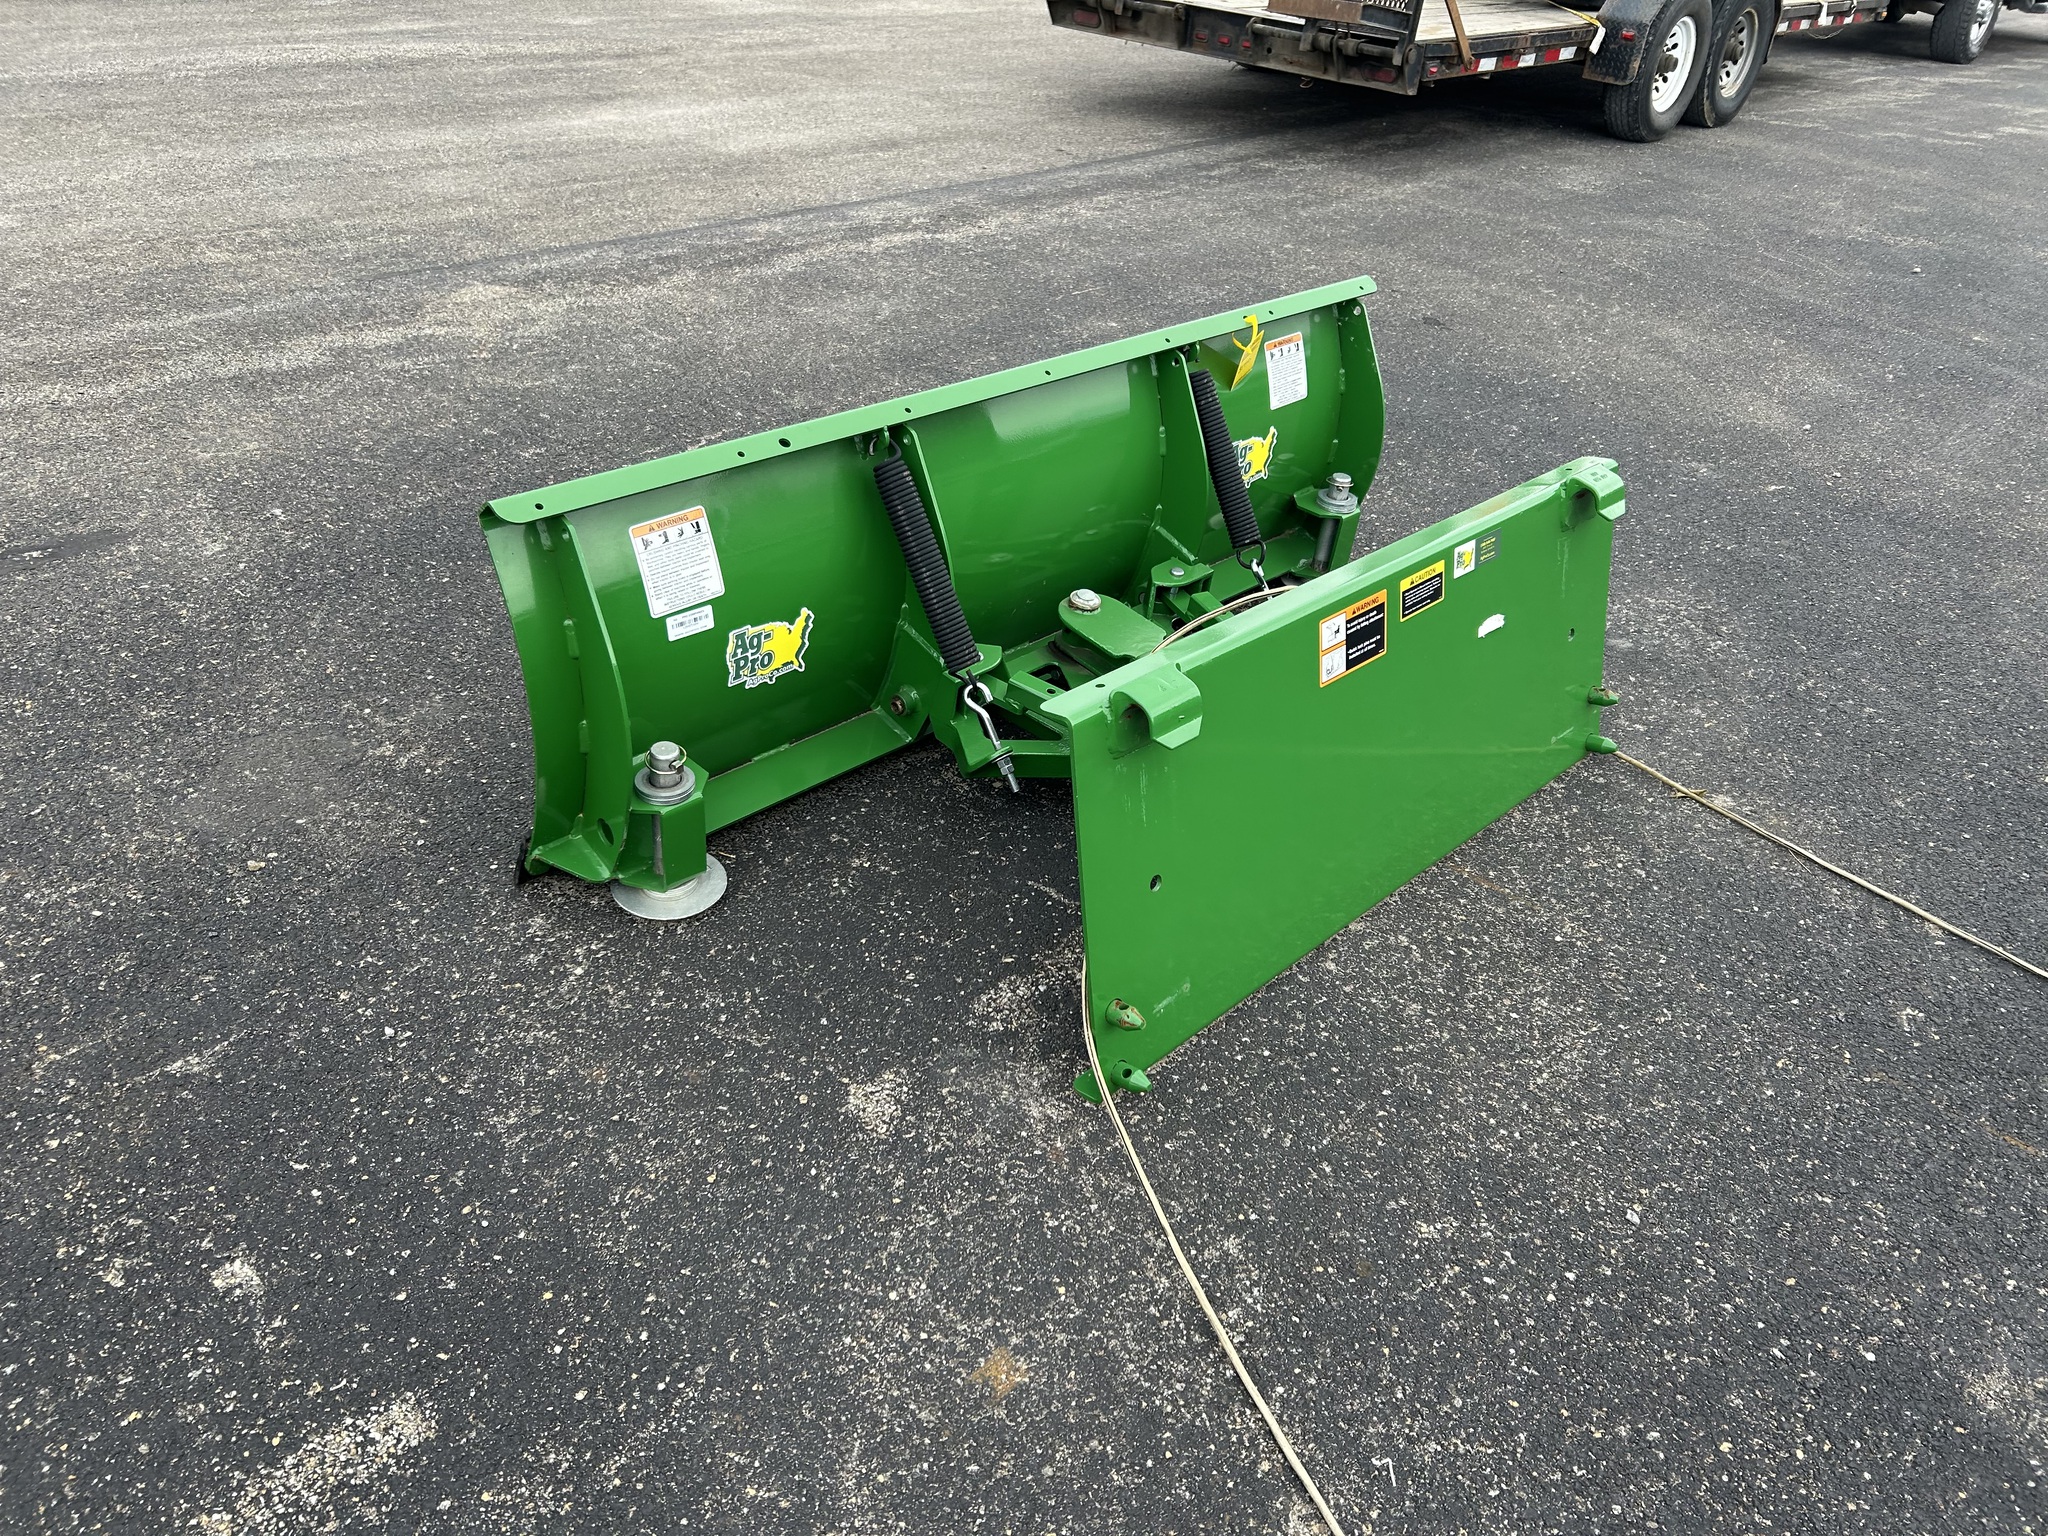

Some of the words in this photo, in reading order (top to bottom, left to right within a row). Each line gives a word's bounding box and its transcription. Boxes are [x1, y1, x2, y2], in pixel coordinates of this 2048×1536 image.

[656, 514, 689, 530] WARNING
[1414, 566, 1437, 584] CAUTION
[1355, 596, 1380, 613] WARNING
[731, 630, 773, 659] Ag-
[732, 651, 775, 682] Pro
